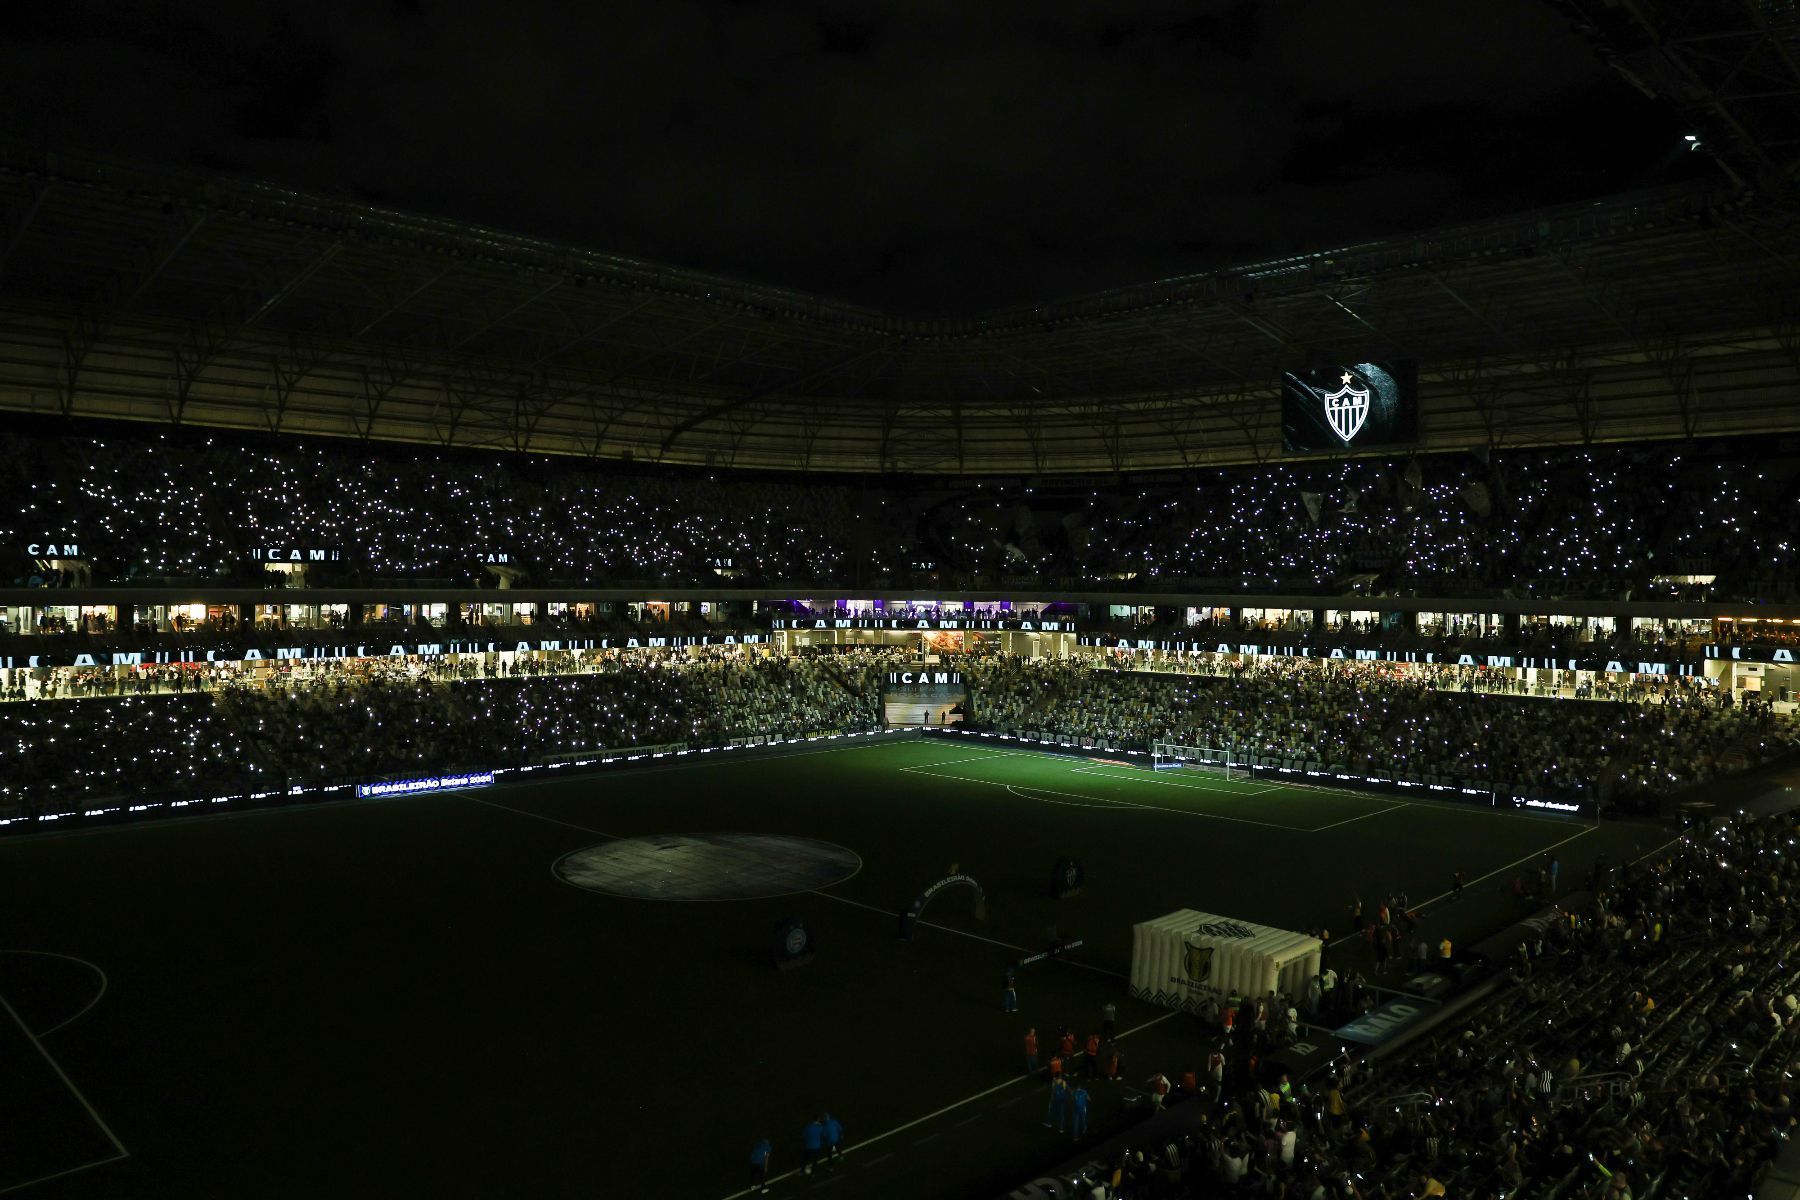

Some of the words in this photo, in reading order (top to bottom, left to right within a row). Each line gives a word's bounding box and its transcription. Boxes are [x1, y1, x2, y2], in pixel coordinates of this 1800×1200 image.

[1331, 397, 1363, 407] CAM
[27, 543, 78, 556] CAM
[268, 548, 325, 560] CAM
[902, 672, 948, 684] CAM
[372, 780, 440, 794] BRASILEIRÃO
